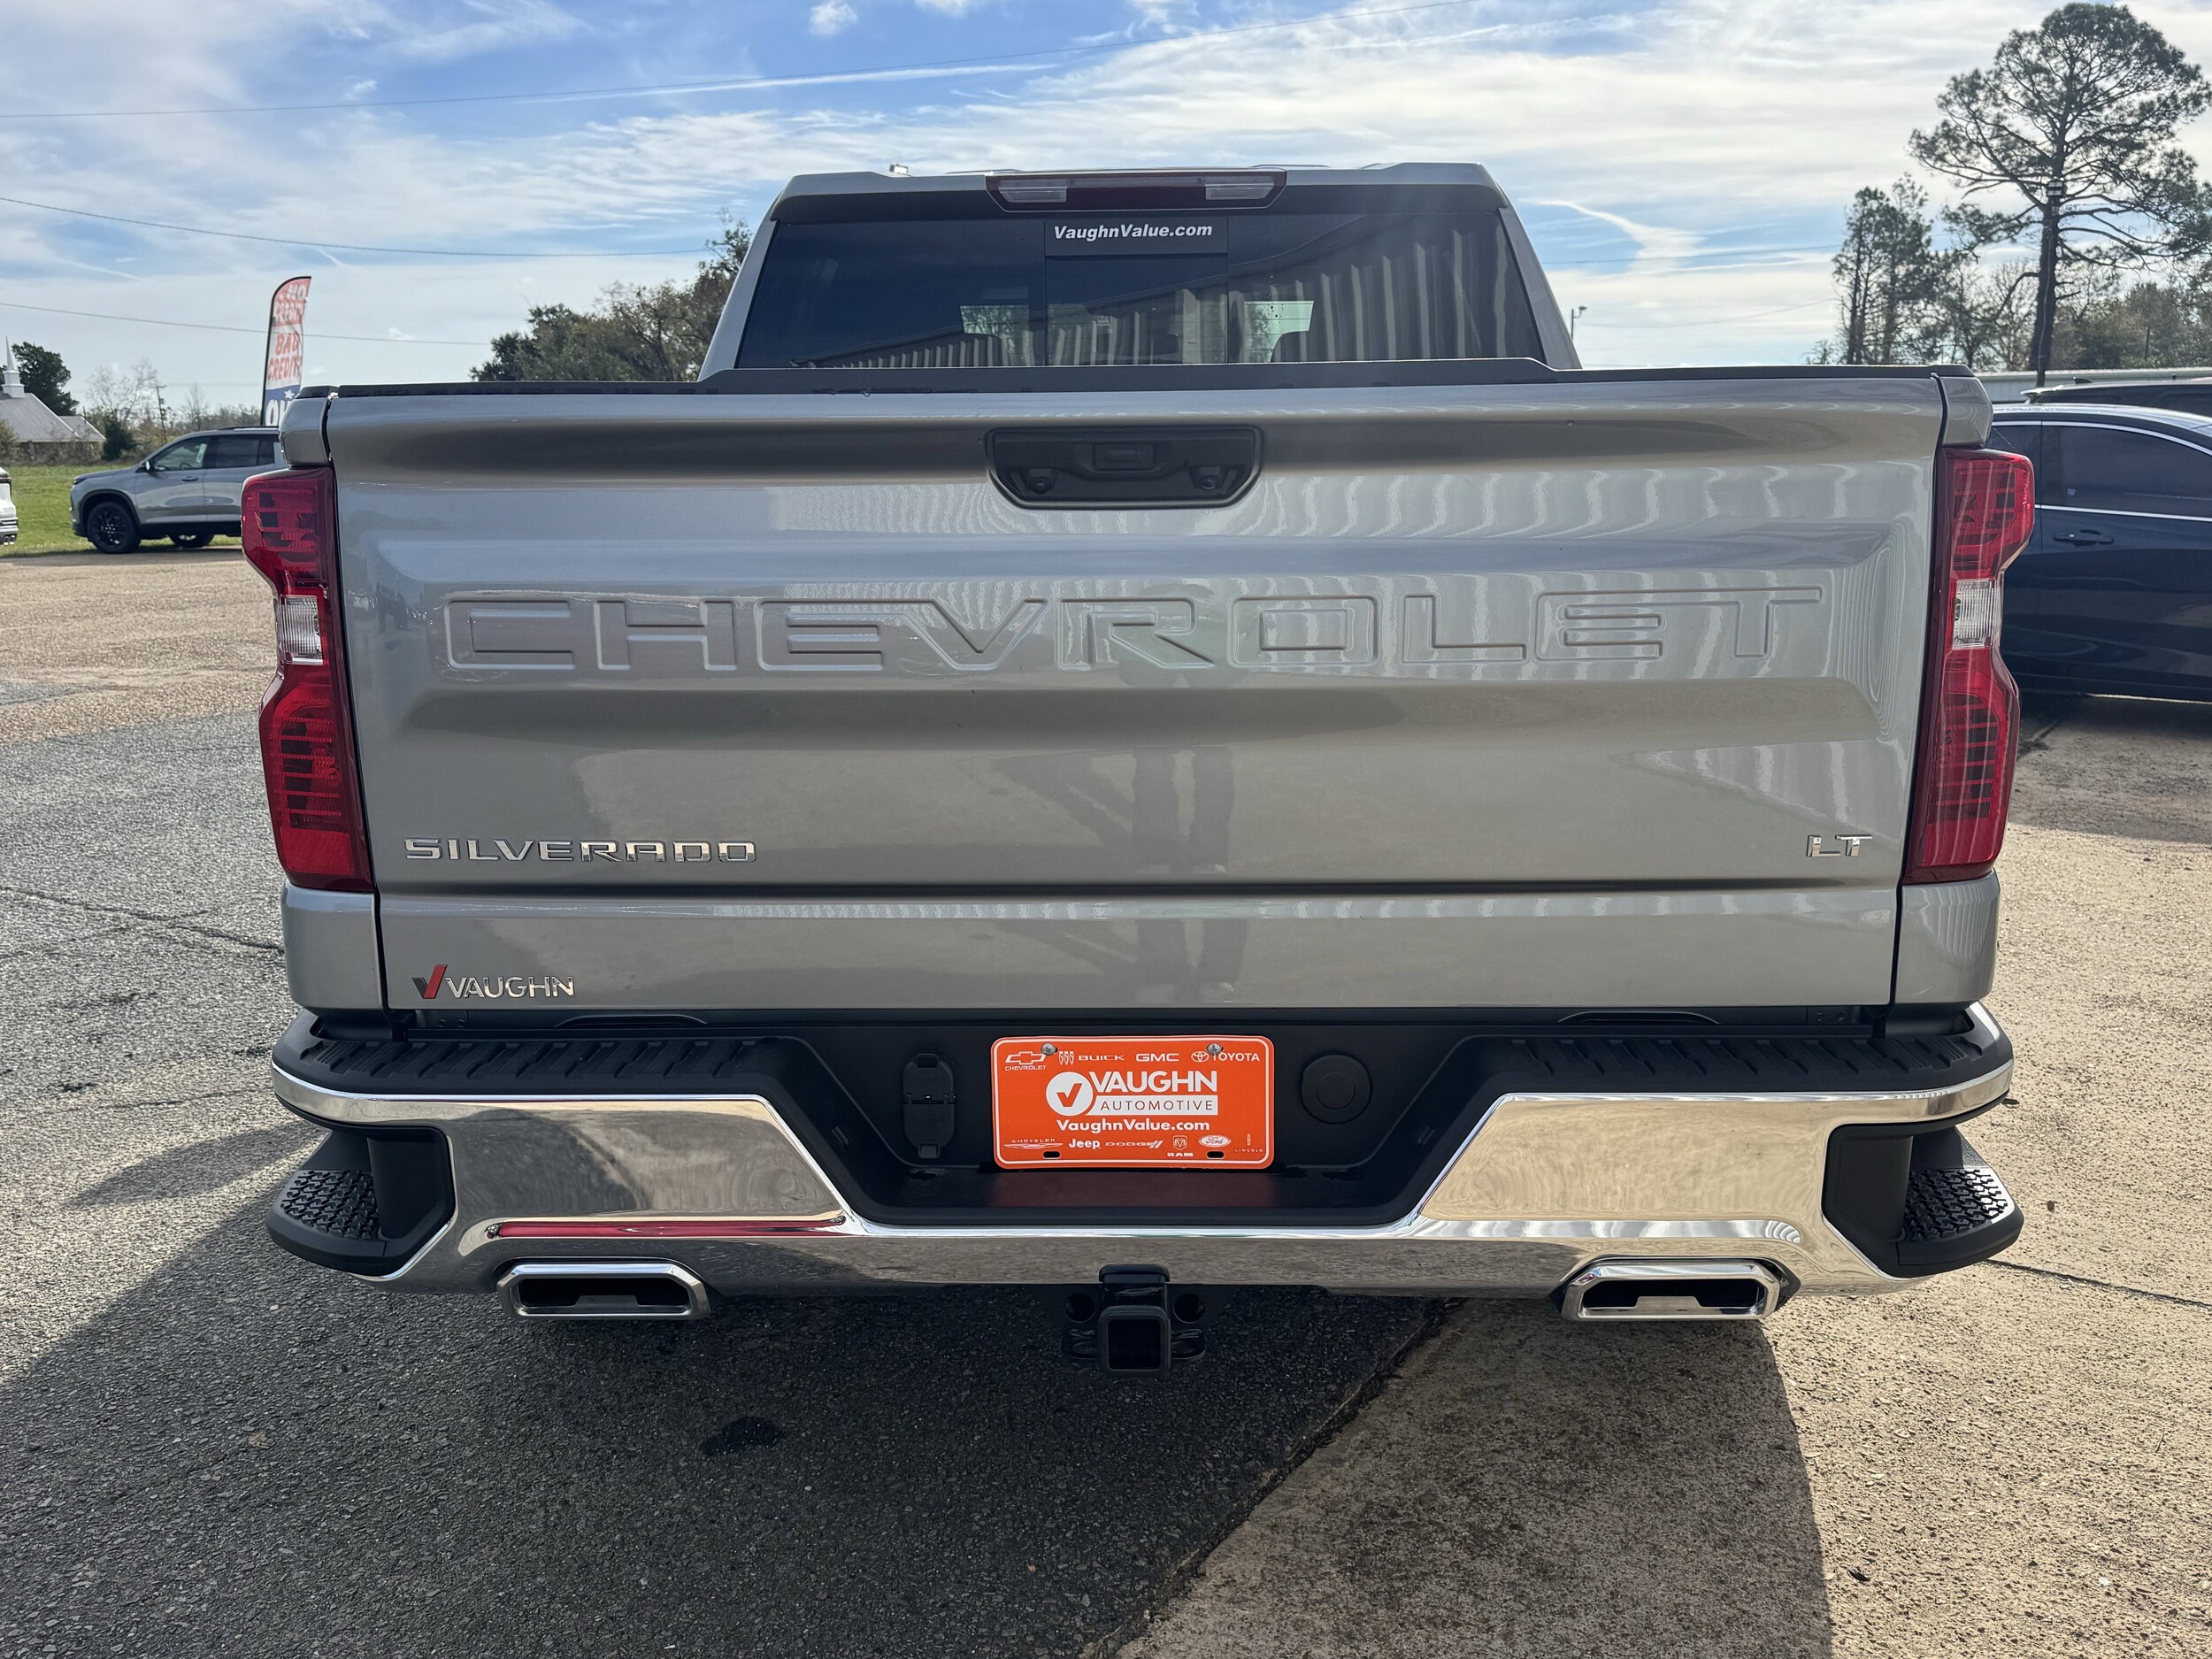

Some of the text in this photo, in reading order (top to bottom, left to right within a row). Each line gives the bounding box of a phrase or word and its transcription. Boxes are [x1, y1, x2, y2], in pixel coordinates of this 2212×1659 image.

[1054, 224, 1213, 242] VaughnValue.com
[275, 332, 300, 355] BAD
[442, 587, 1824, 672] CHEVROLET
[403, 838, 757, 863] SILVERADO
[1806, 834, 1873, 857] LT
[446, 975, 574, 999] VAUGHN
[1135, 1053, 1179, 1062] GMC
[1088, 1070, 1217, 1094] VAUGHN
[1100, 1100, 1213, 1111] AUTOMOTIVE
[1056, 1118, 1210, 1134] VaughnValue.com
[1068, 1138, 1101, 1149] Jeep
[1205, 1135, 1224, 1145] Ford
